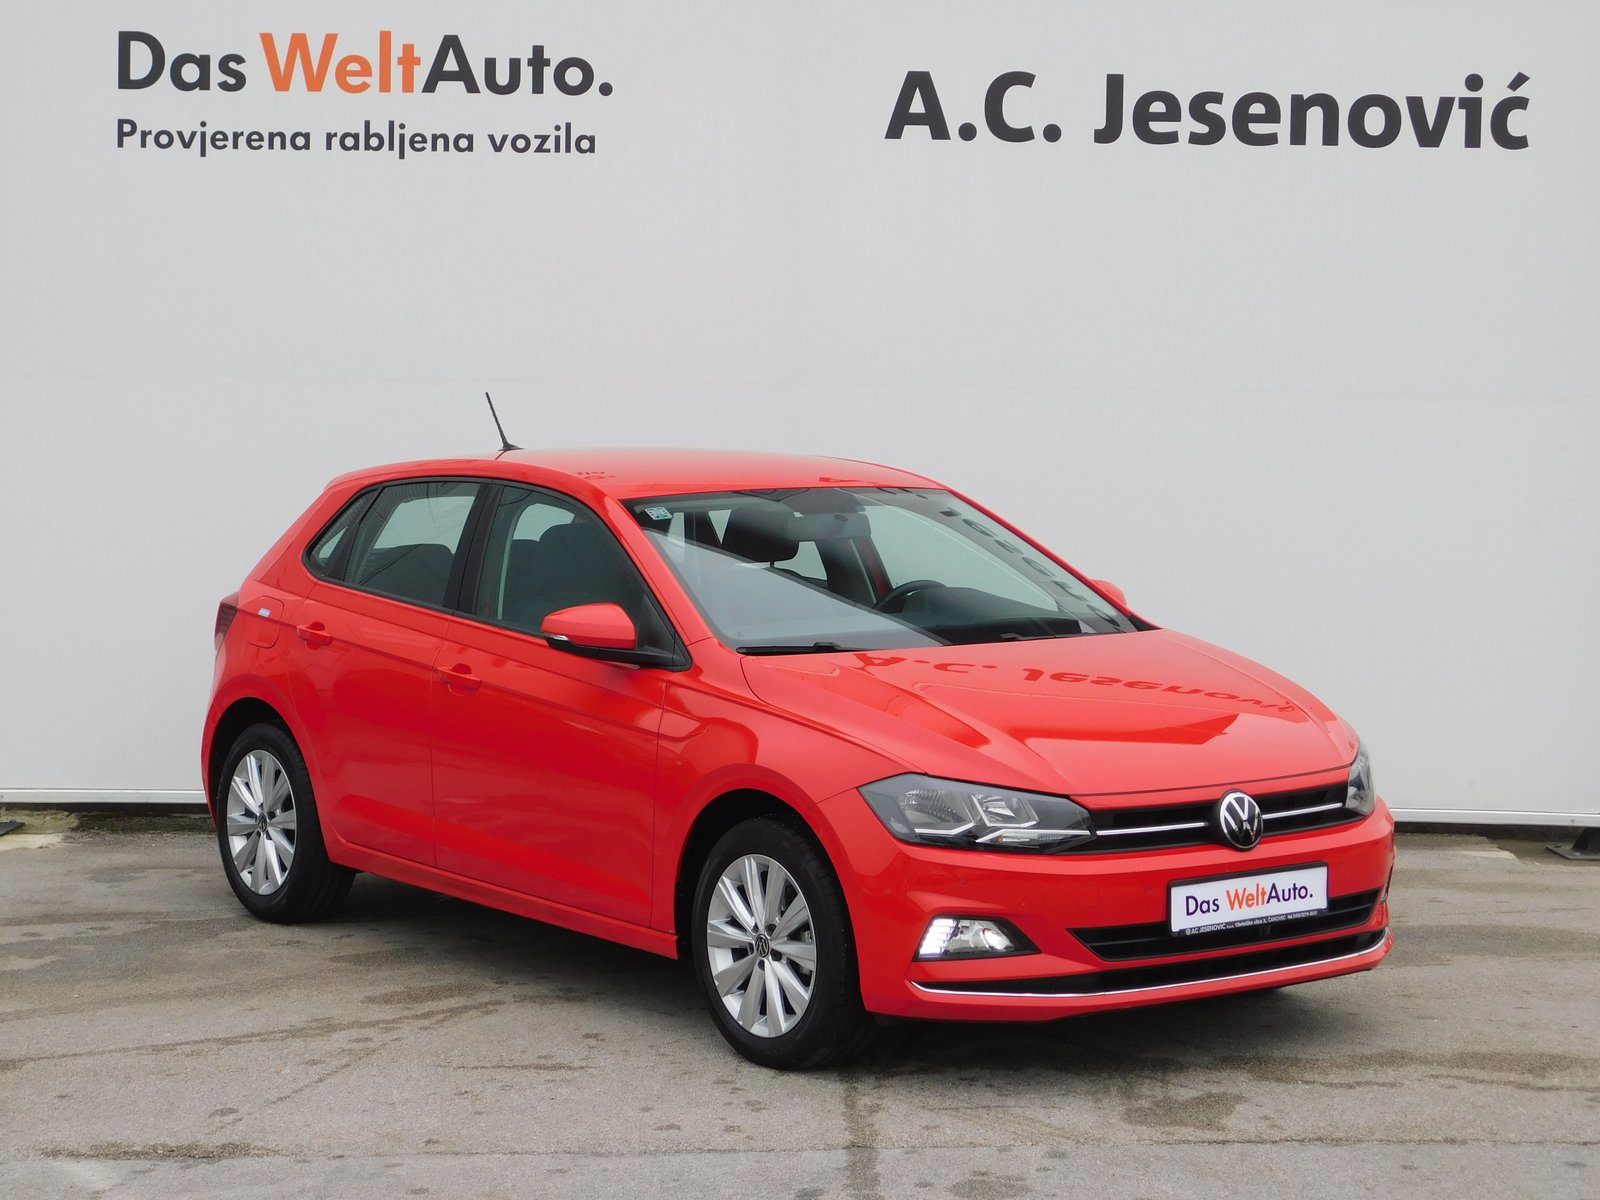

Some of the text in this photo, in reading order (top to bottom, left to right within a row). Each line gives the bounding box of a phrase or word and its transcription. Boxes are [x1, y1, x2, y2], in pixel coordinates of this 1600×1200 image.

[117, 30, 614, 96] Das WeltAuto.
[884, 70, 1531, 151] A.C. Jesenović
[117, 118, 596, 160] Provjerena rabljena vozila
[1185, 882, 1314, 917] Das WeltAuto.
